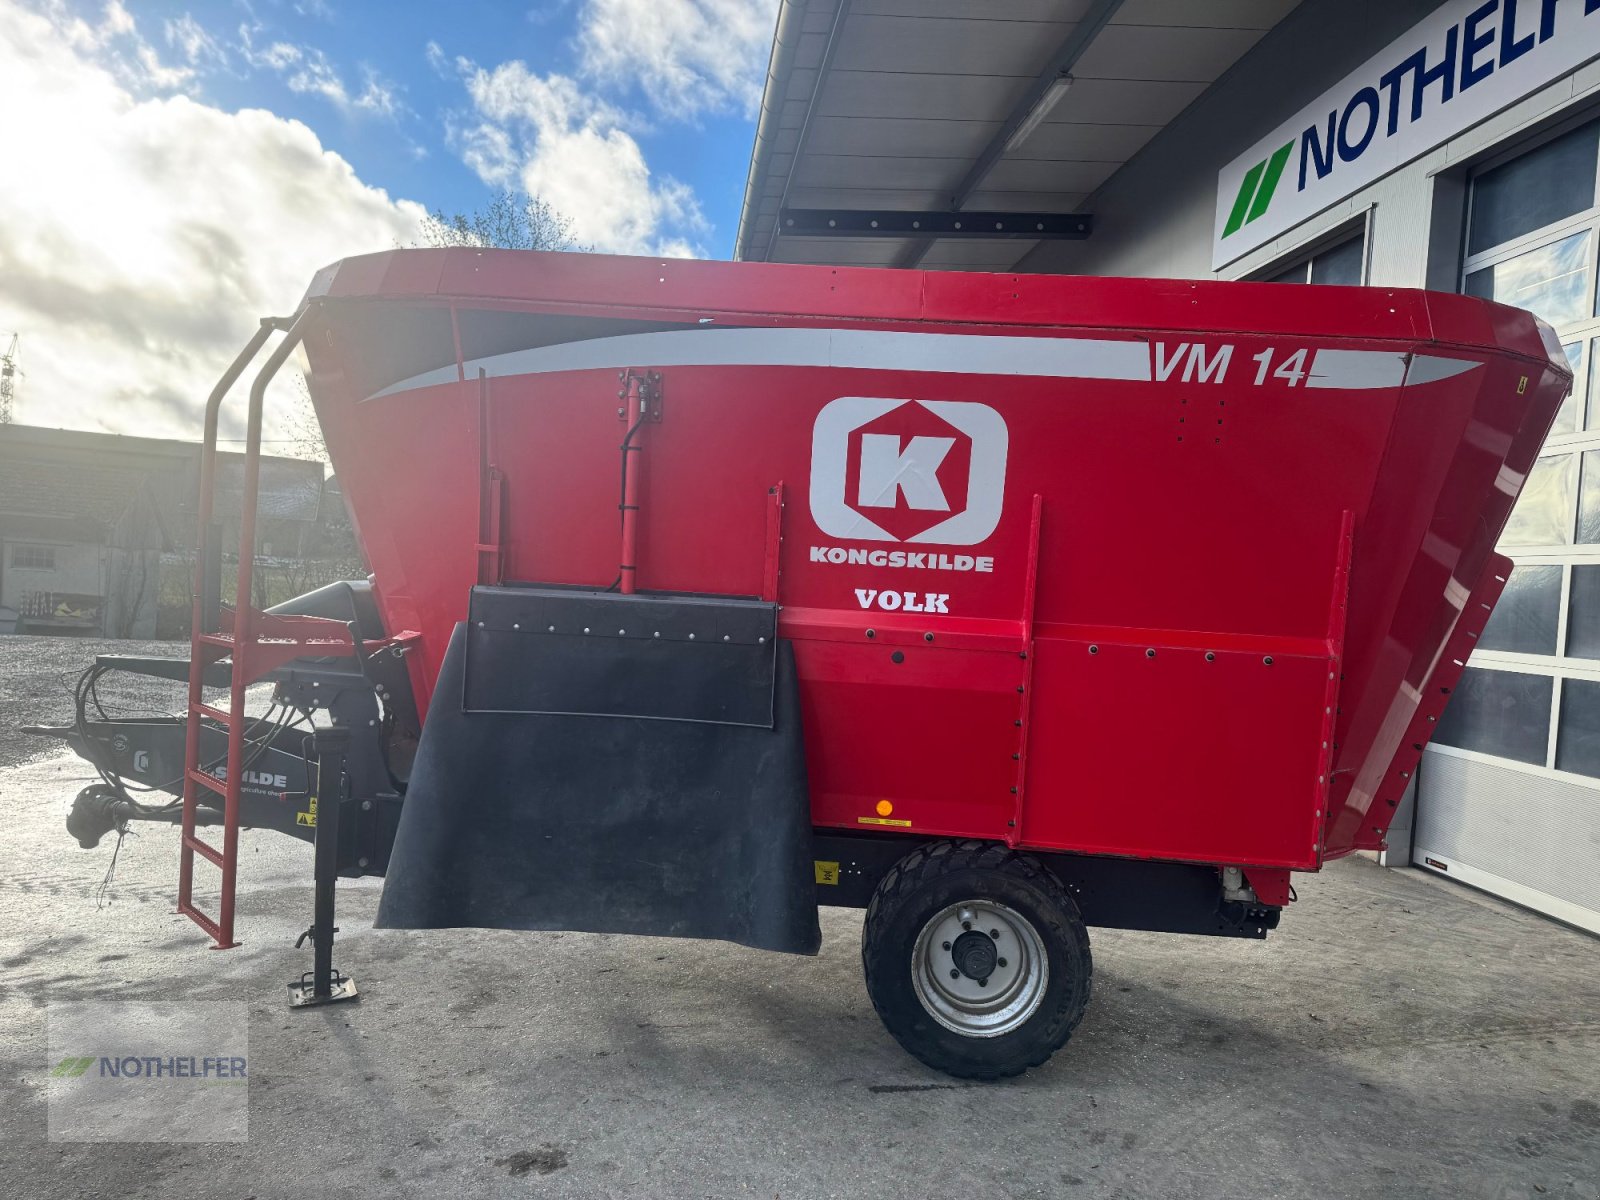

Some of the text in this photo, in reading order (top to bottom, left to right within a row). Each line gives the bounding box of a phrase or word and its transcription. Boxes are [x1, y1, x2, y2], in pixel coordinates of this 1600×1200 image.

[1155, 341, 1309, 388] VM 14
[858, 433, 957, 512] K
[809, 546, 994, 573] KONGSKILDE
[854, 588, 950, 614] VOLK
